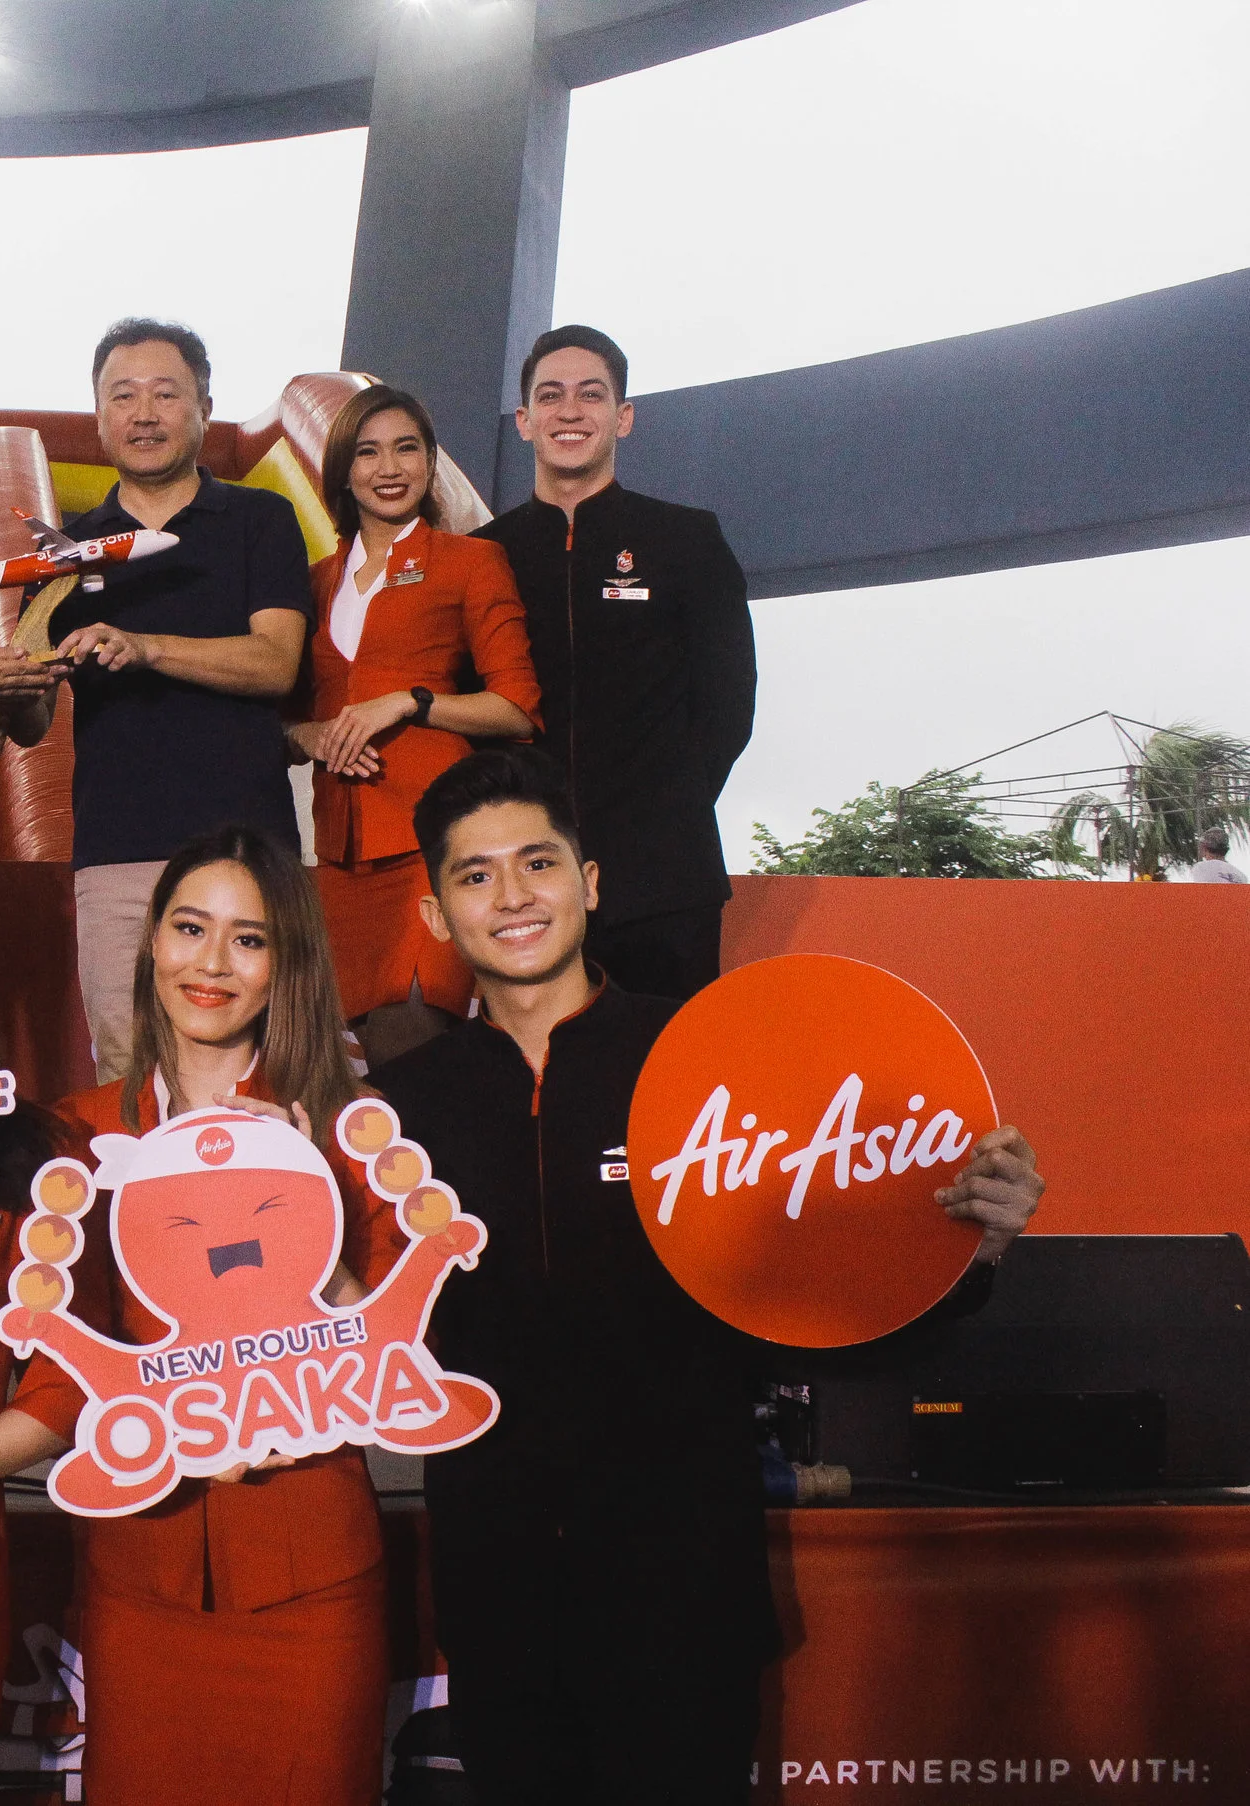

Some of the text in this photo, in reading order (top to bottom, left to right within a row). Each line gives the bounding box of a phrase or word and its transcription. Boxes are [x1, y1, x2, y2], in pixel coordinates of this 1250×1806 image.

[651, 1073, 973, 1226] AirAsia
[141, 1315, 367, 1384] NEW ROUTE!
[94, 1348, 444, 1470] OSAKA
[781, 1758, 1071, 1785] PARTNERSHIP
[1089, 1757, 1211, 1784] WITH:
